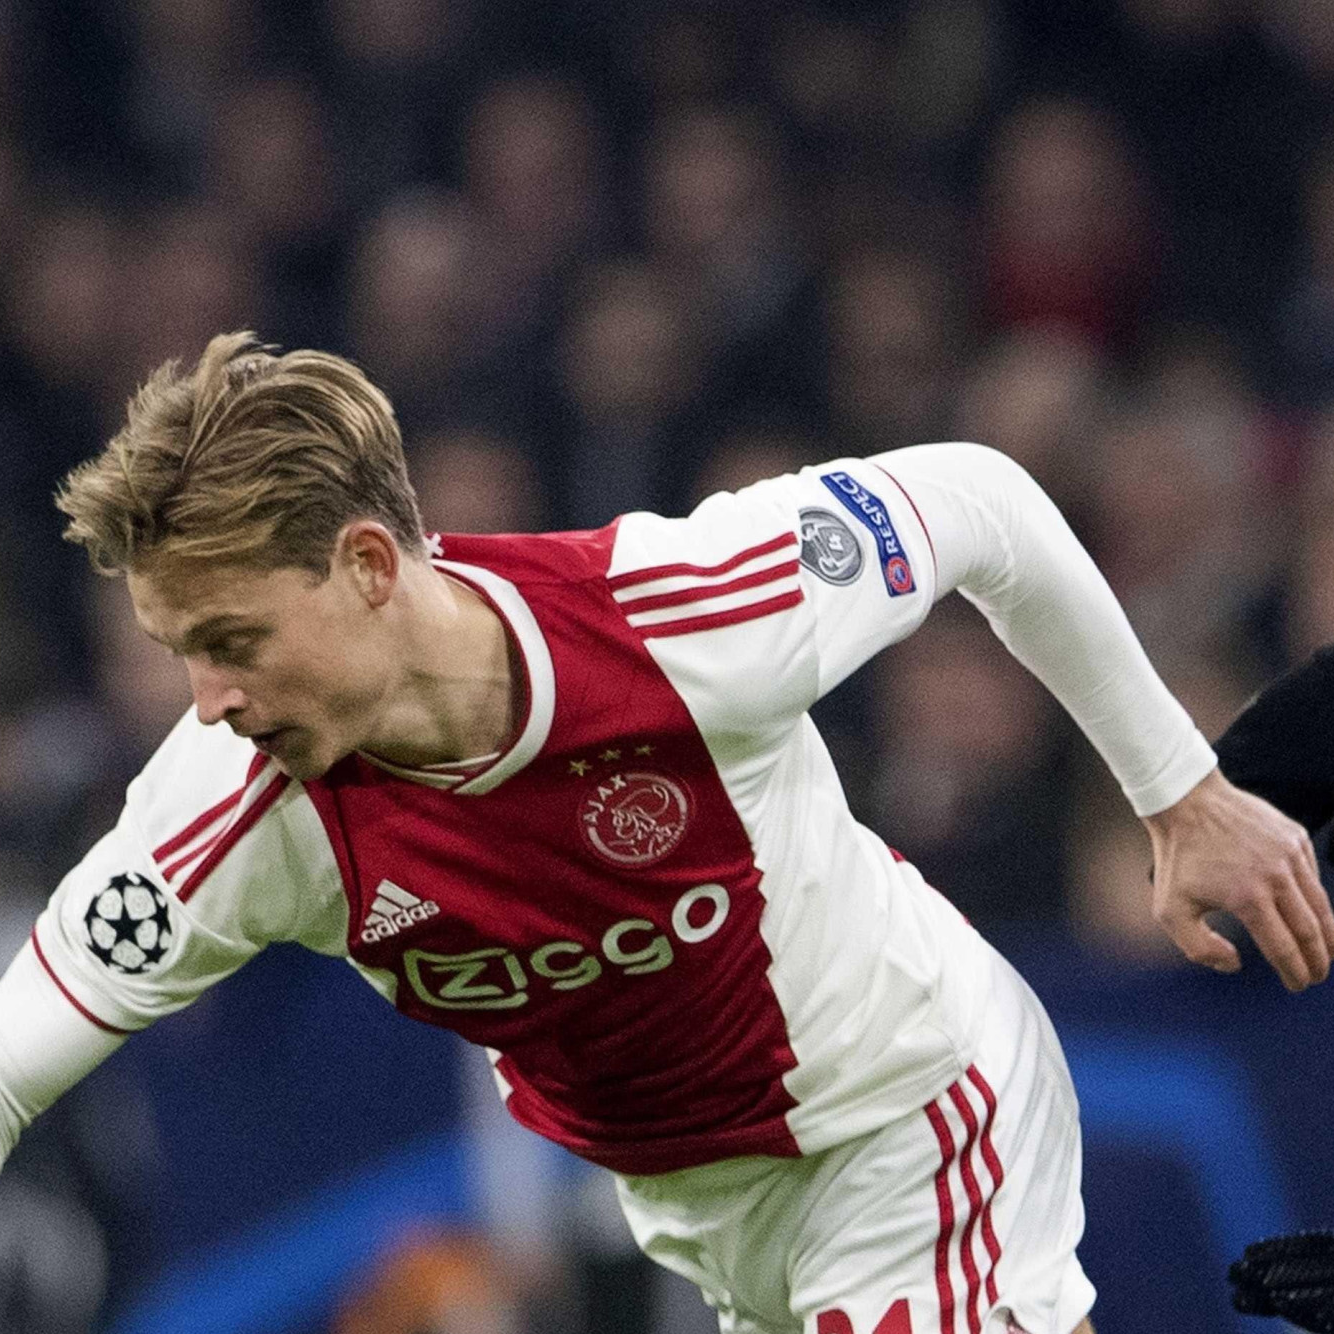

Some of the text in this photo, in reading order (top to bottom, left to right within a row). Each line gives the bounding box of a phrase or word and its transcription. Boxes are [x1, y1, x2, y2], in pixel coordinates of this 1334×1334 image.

[829, 473, 899, 554] RESPECT
[583, 774, 627, 825] AJAX
[361, 899, 441, 944] adidas
